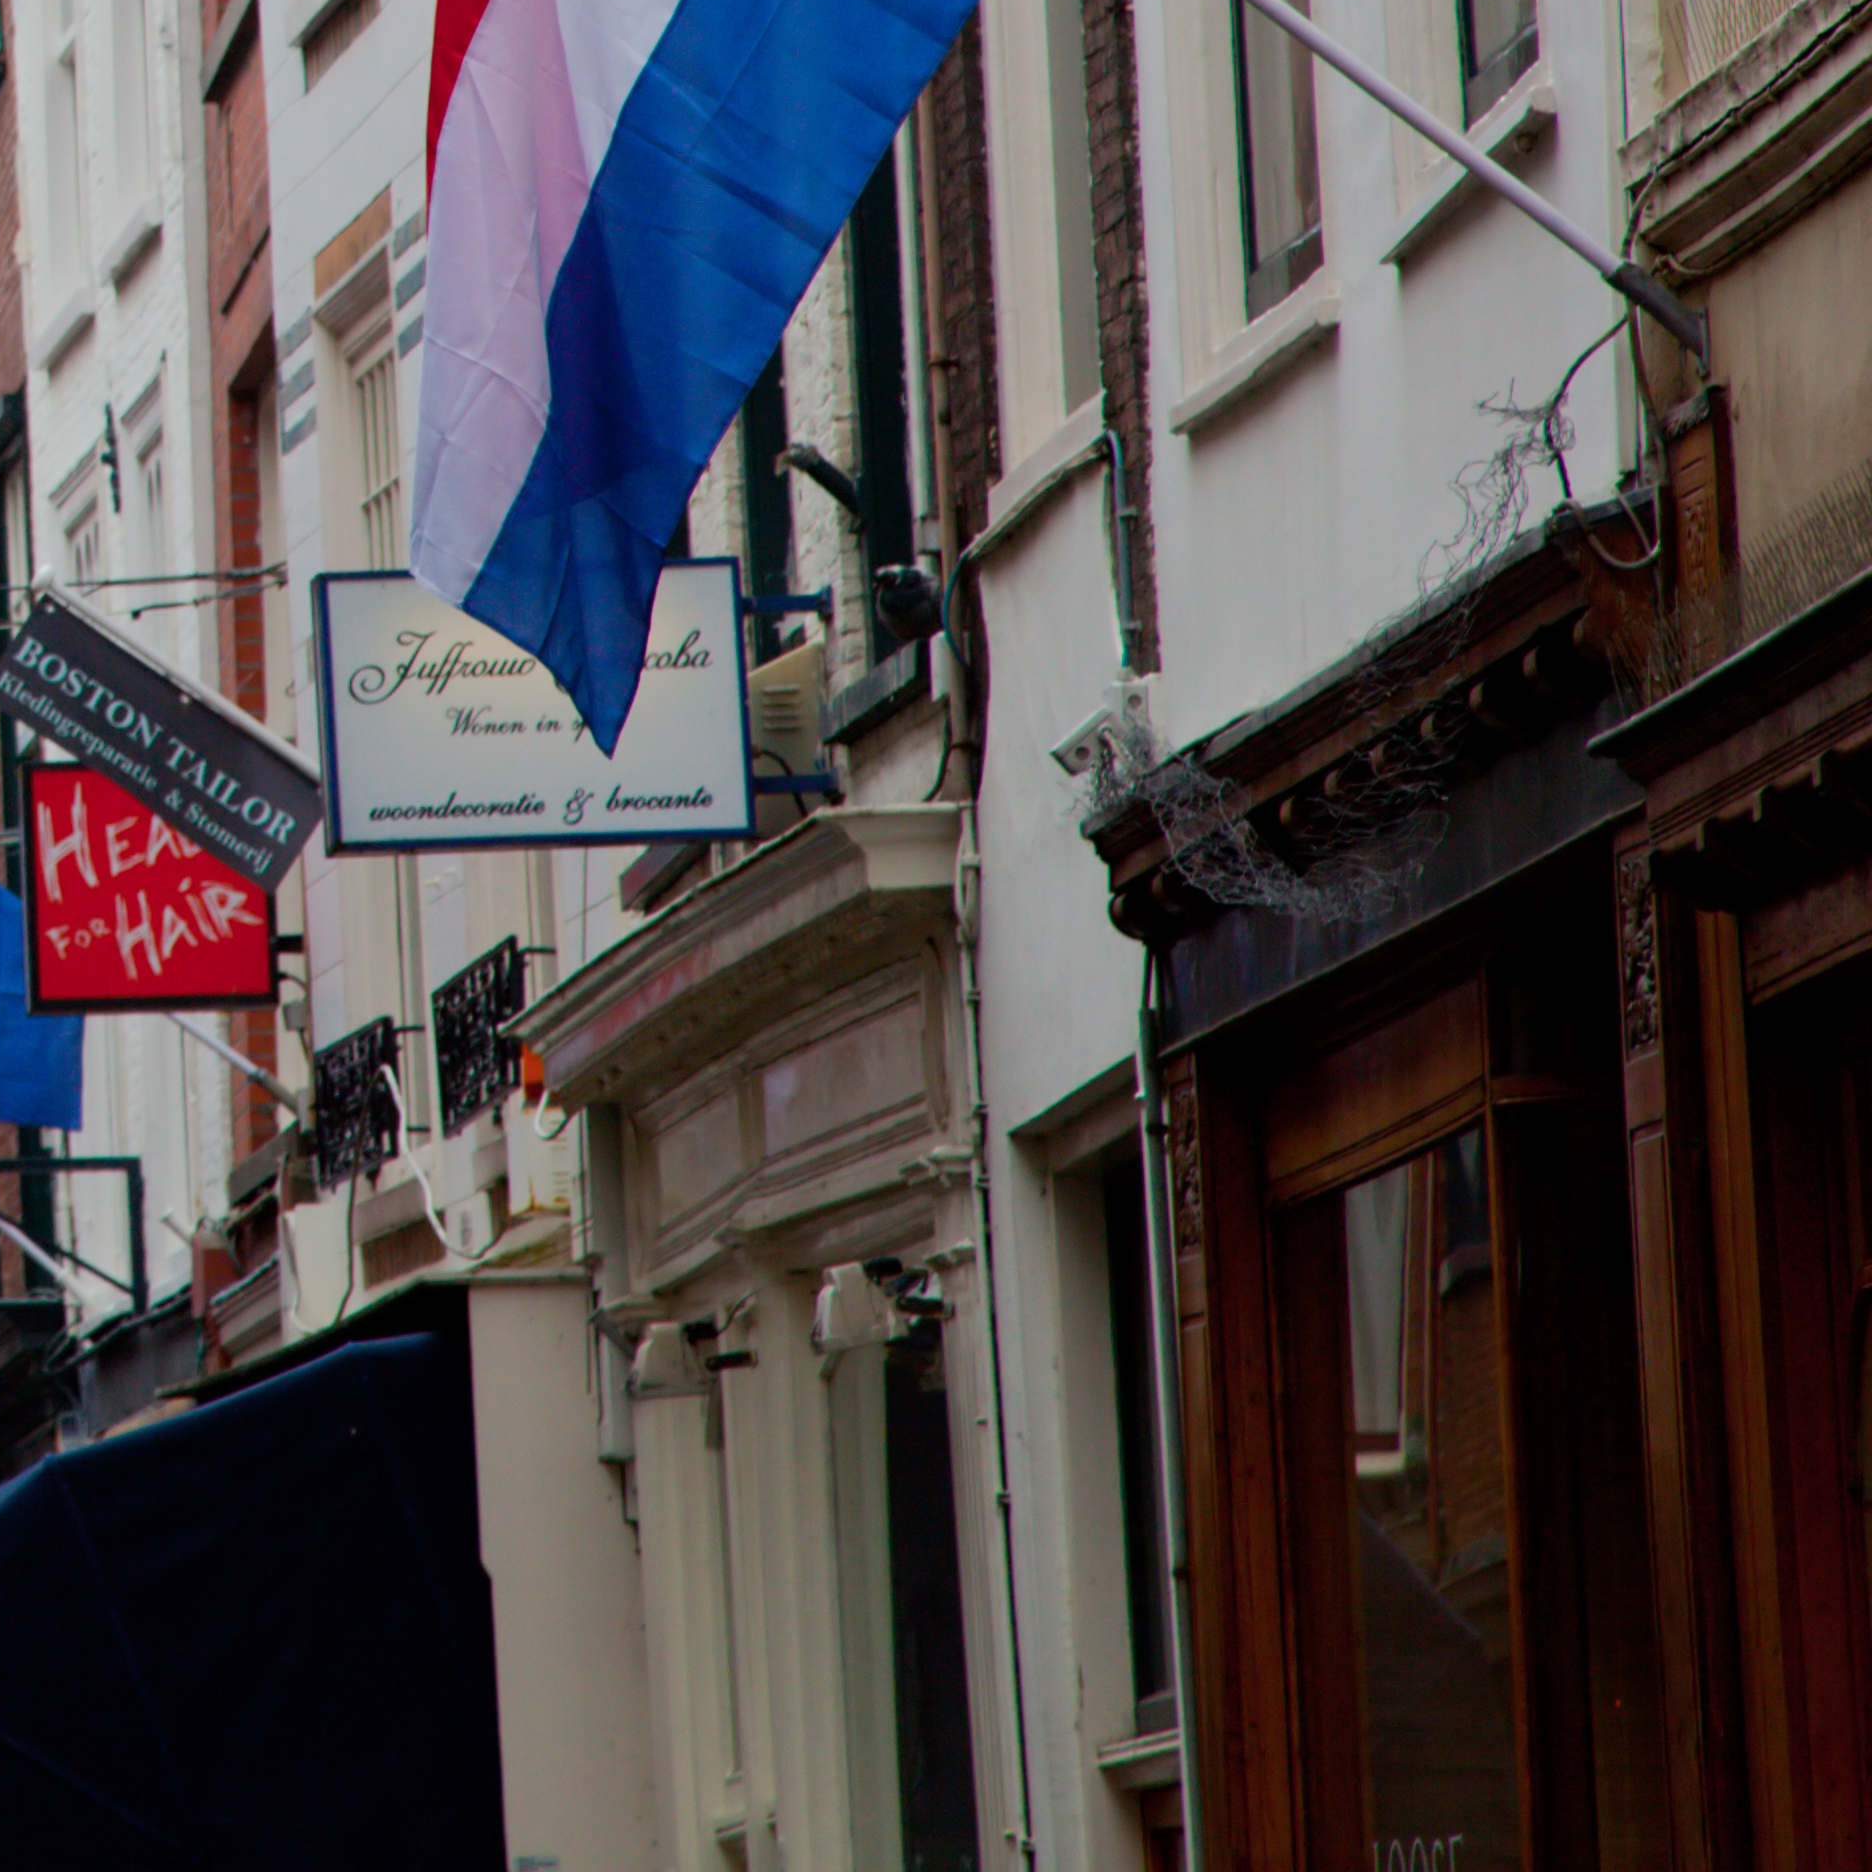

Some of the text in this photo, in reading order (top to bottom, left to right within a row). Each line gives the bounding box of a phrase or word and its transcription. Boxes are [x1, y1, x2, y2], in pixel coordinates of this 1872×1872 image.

[12, 635, 298, 845] BOSTON TAILOR
[445, 704, 527, 737] Wonen
[535, 713, 563, 734] in
[163, 787, 183, 813] &
[184, 801, 274, 875] Stomerij
[368, 784, 714, 826] woondecoratie & brocante
